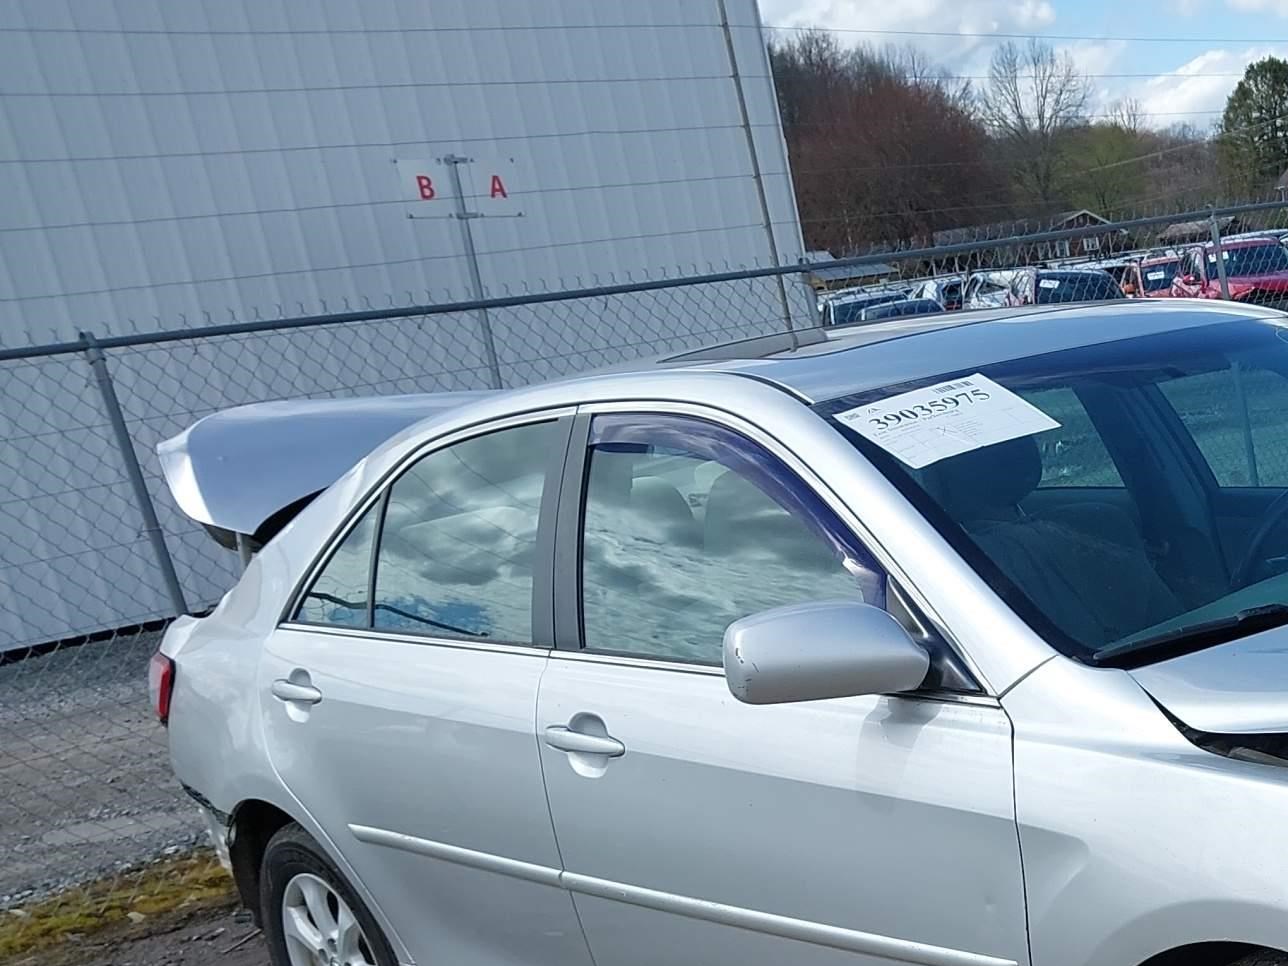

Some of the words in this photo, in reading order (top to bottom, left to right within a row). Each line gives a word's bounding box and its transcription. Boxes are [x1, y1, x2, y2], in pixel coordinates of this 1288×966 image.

[416, 175, 435, 199] B
[491, 175, 508, 198] A
[868, 388, 991, 431] 39035975
